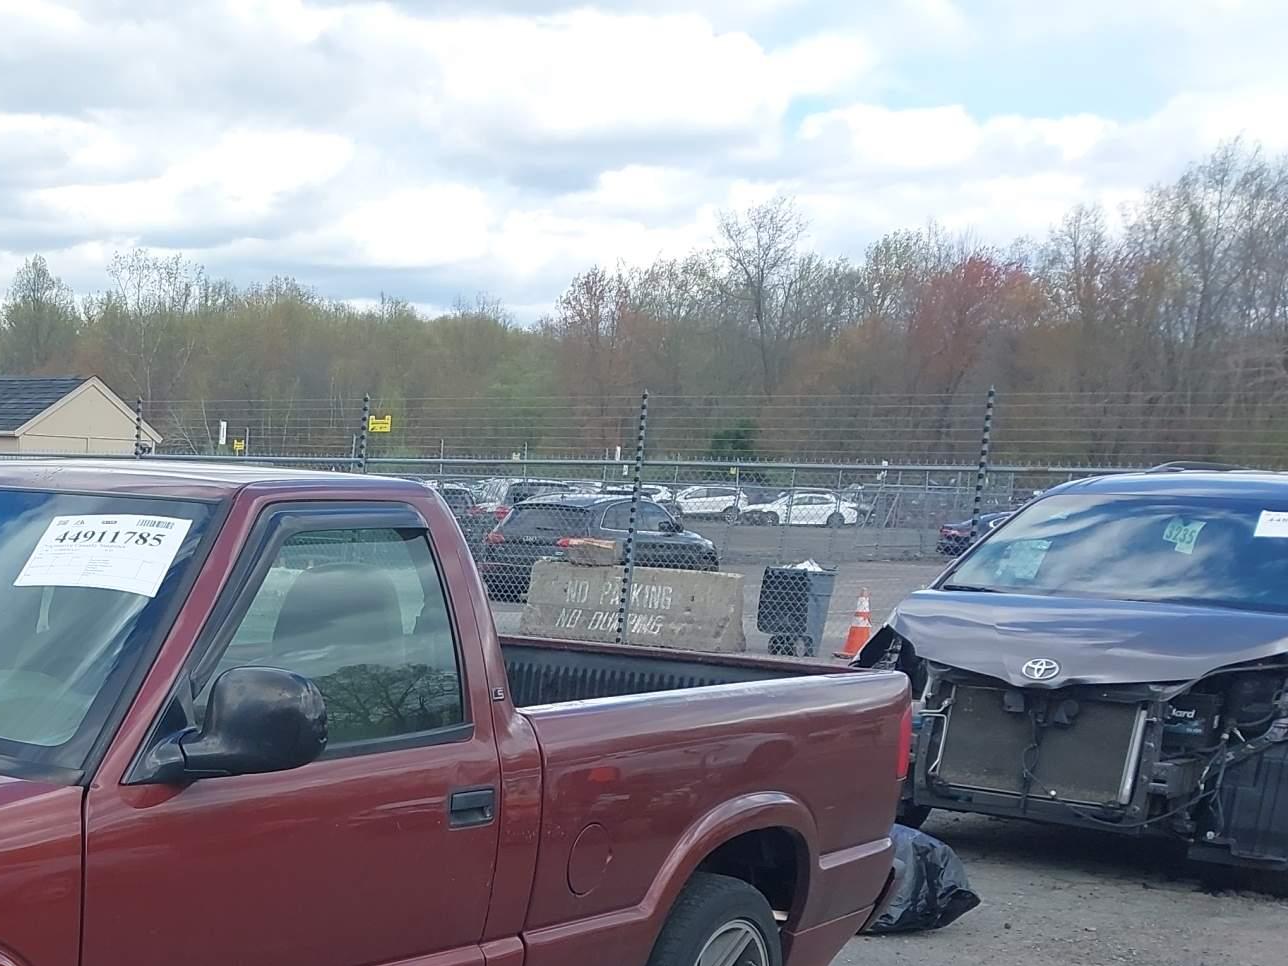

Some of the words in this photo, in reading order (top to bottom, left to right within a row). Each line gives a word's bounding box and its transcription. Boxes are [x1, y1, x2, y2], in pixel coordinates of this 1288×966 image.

[54, 530, 166, 547] 44911785
[565, 579, 590, 604] NO
[599, 581, 673, 610] PAKING
[555, 607, 583, 629] NO
